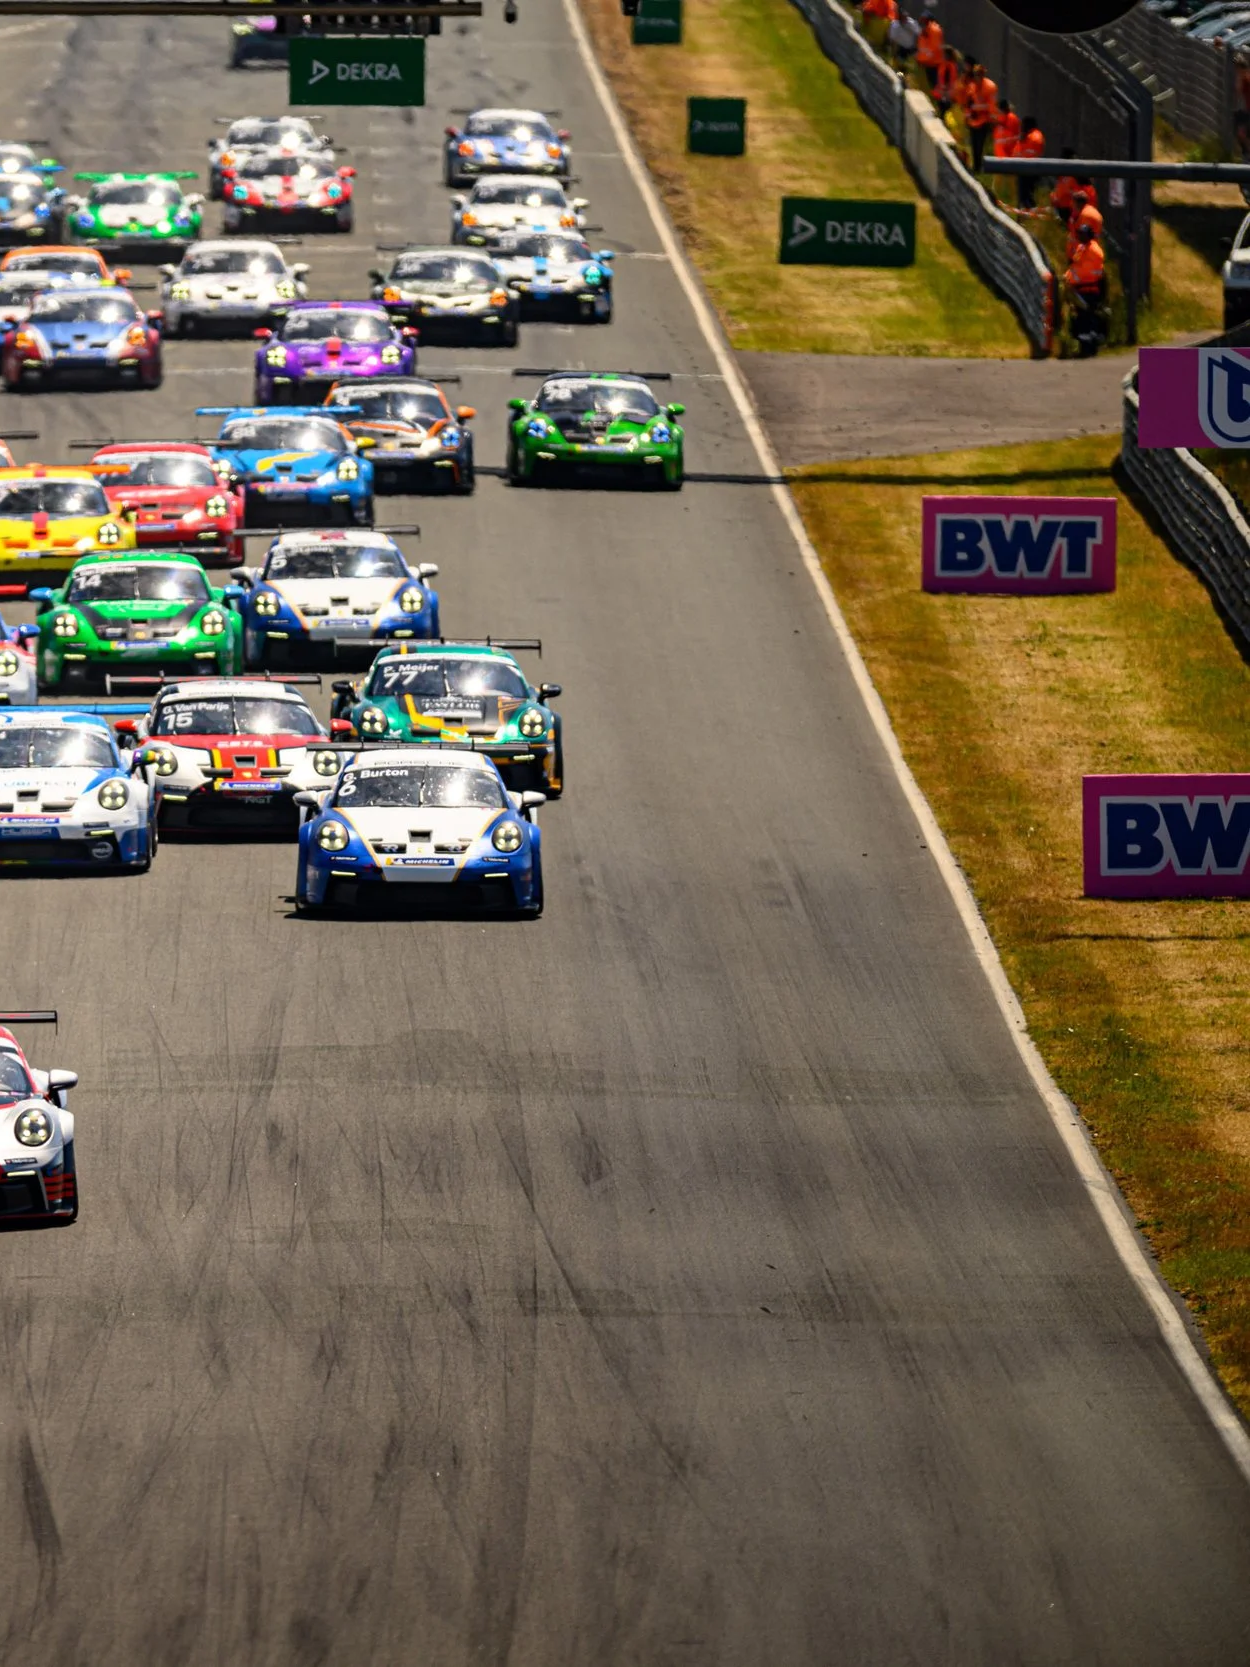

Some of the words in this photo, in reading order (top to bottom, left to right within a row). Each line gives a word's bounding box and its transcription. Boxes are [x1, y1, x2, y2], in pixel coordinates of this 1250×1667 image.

[336, 62, 402, 81] DEKRA
[825, 220, 907, 247] DEKRA
[938, 516, 1099, 576] BWT
[271, 555, 287, 570] 5
[75, 574, 101, 590] 14
[383, 671, 419, 688] 77
[163, 712, 193, 730] 15
[343, 772, 357, 783] G.
[360, 769, 409, 780] Burton
[338, 782, 356, 797] 6
